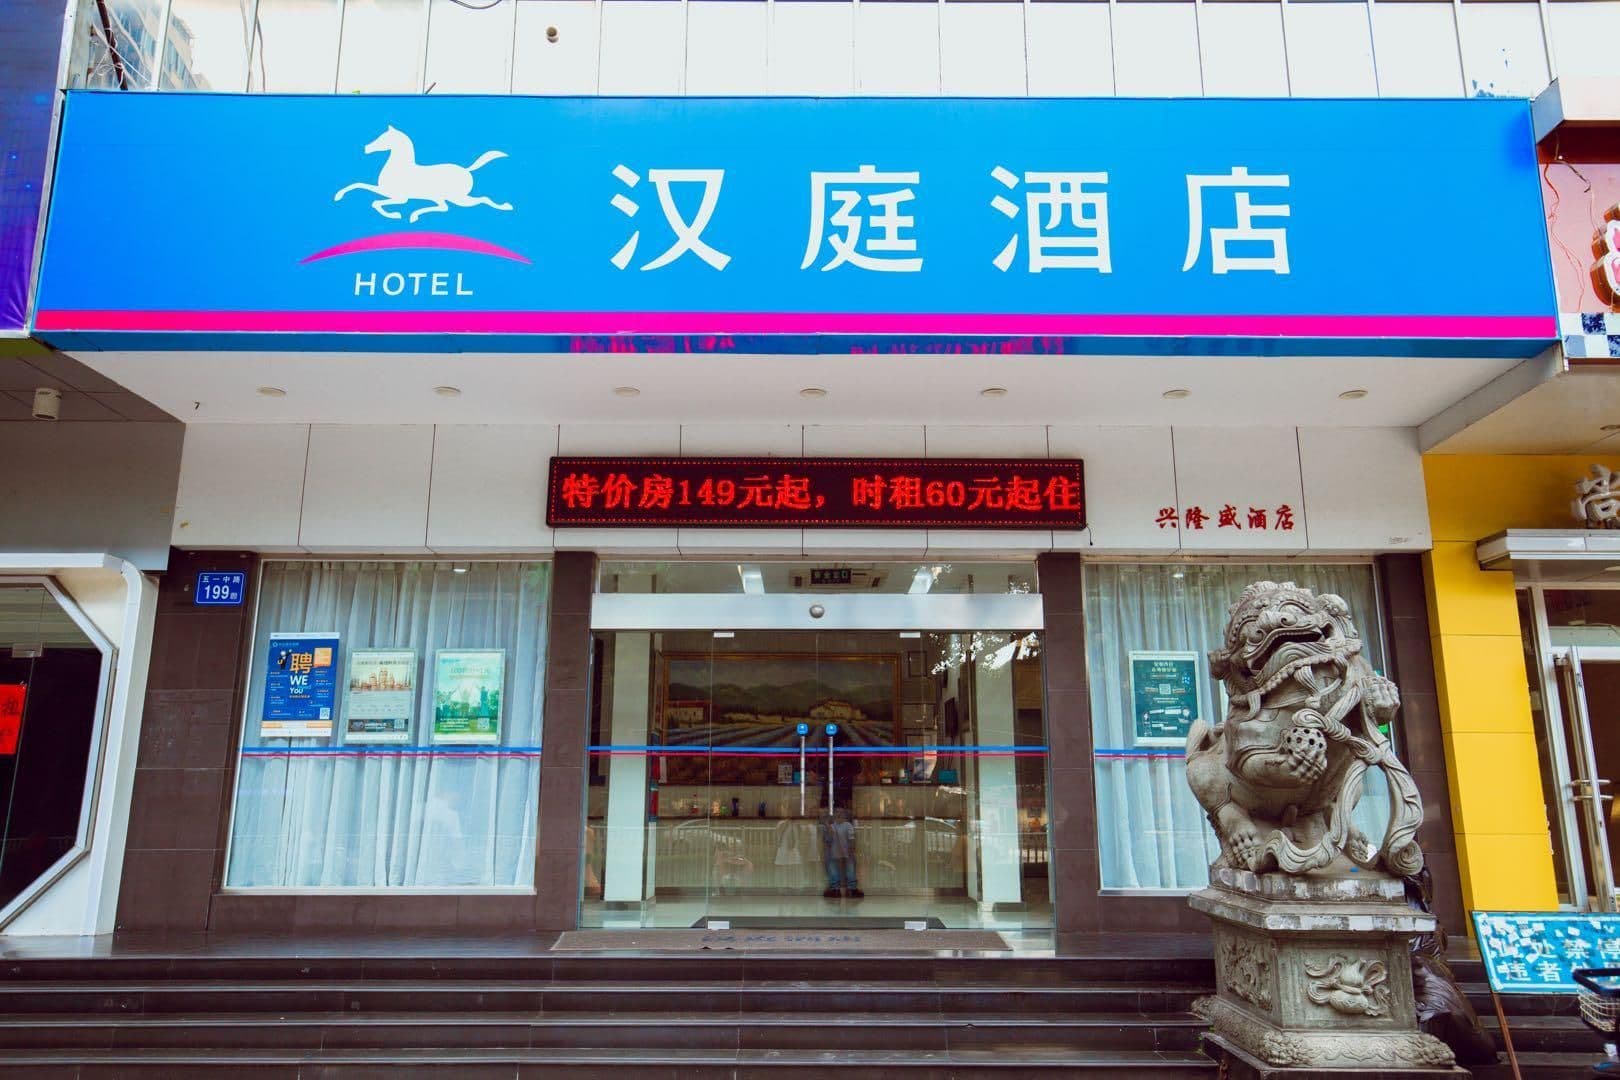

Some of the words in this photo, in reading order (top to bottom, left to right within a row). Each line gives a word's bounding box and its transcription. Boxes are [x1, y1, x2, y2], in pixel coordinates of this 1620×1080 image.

[610, 163, 1292, 275] 汉庭酒店
[354, 272, 474, 297] HOTEL
[1155, 503, 1296, 531] 兴隆盛酒店
[289, 652, 313, 674] 聘
[289, 674, 309, 686] WE
